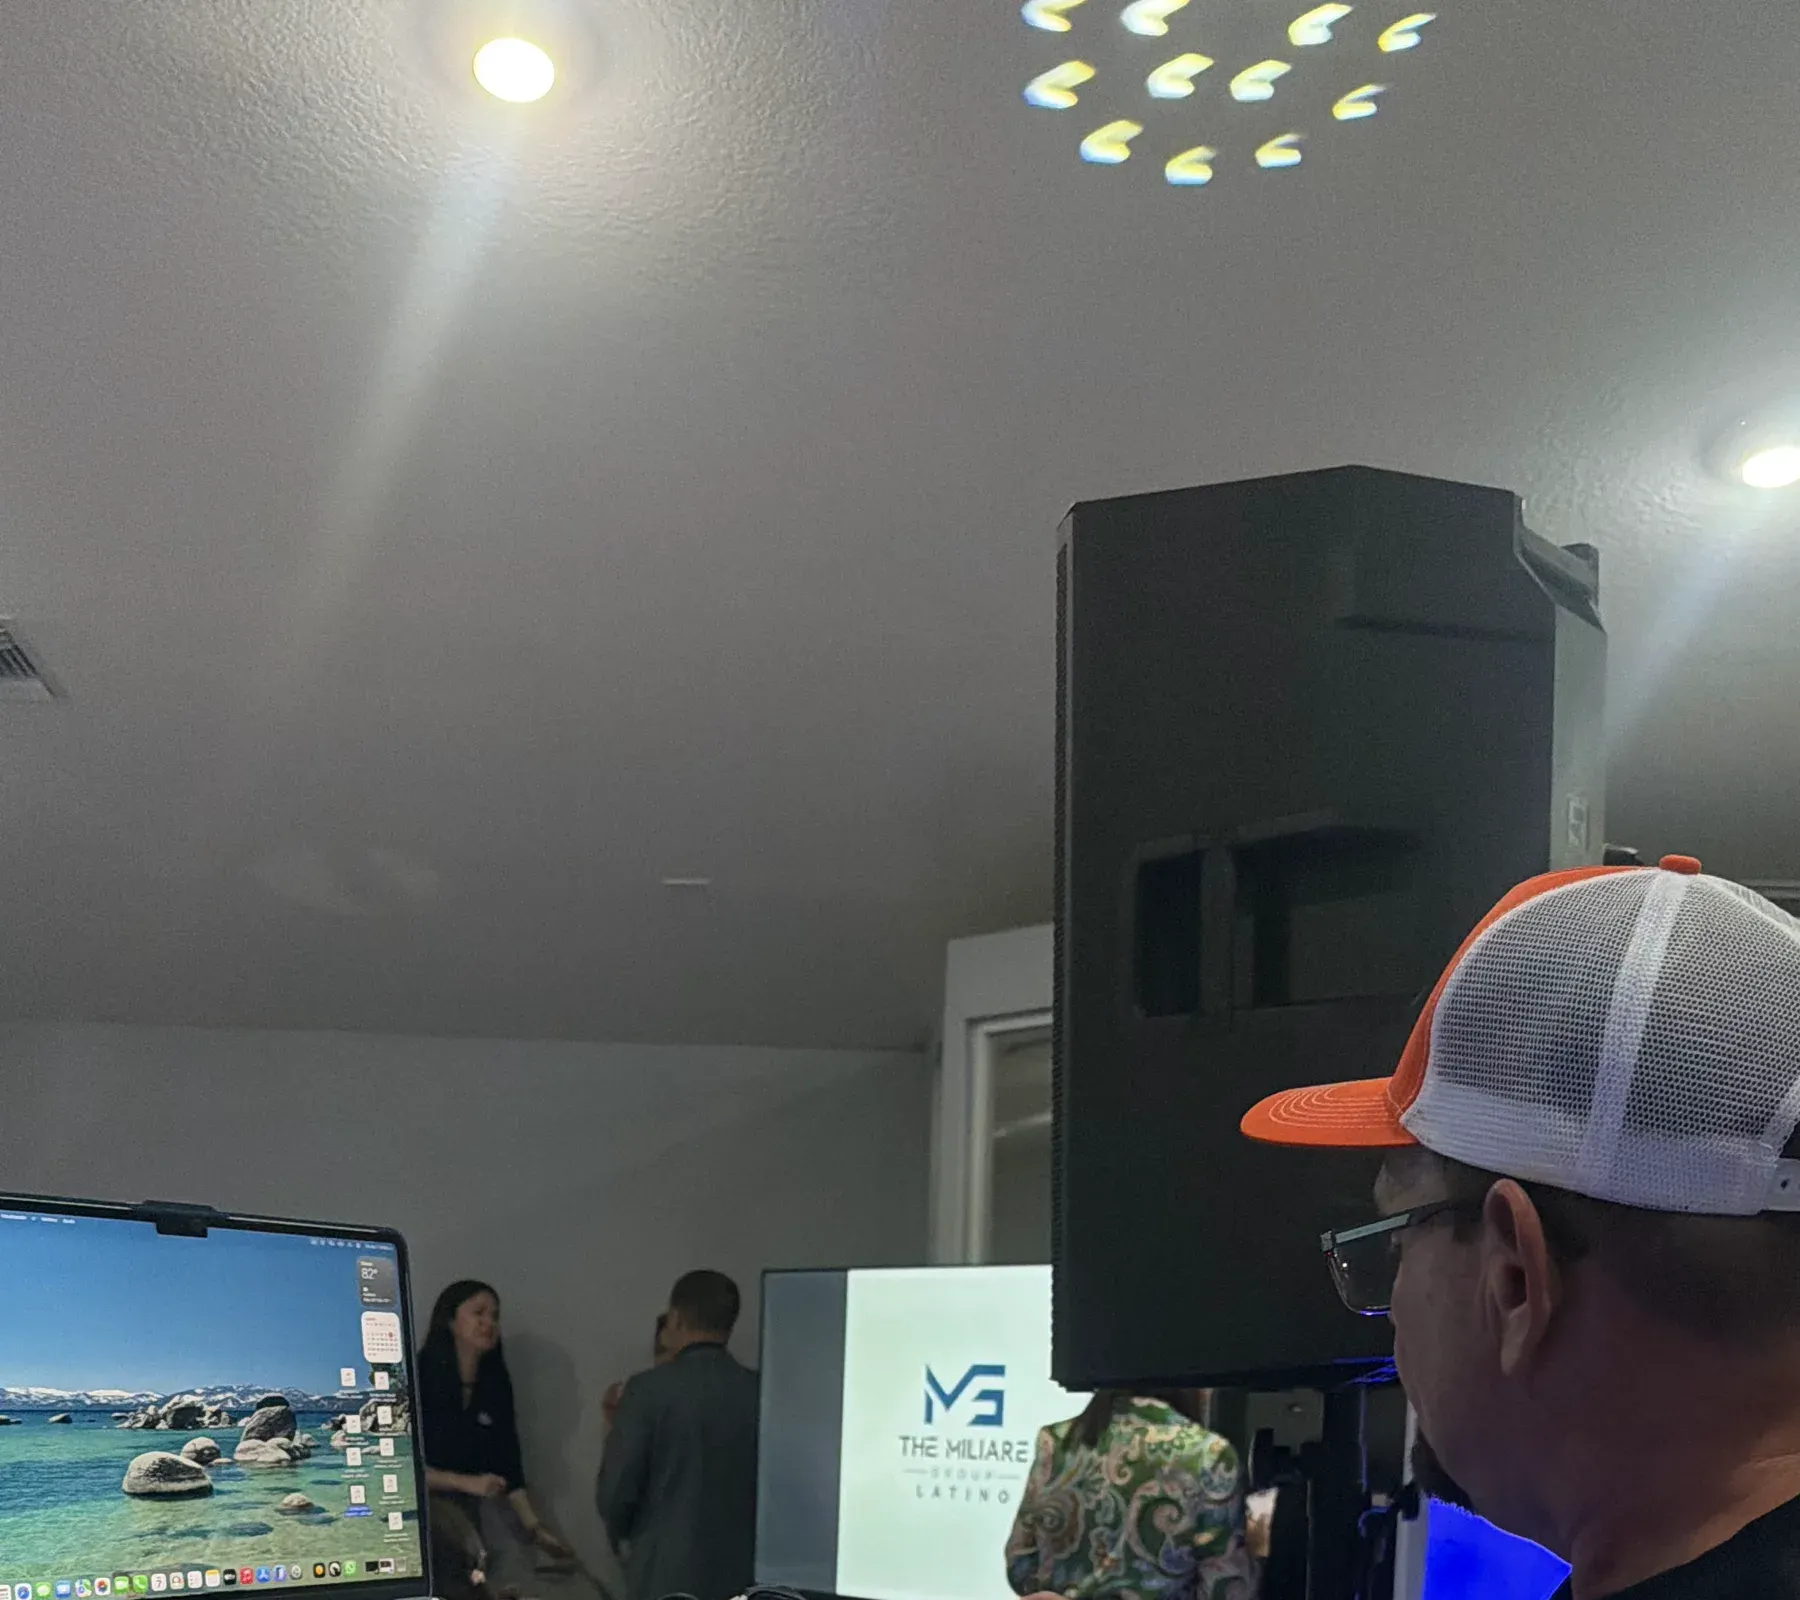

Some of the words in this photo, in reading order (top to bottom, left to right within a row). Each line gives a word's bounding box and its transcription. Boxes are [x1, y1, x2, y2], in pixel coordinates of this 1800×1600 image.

[899, 1435, 938, 1458] THE
[945, 1438, 1029, 1463] MILIARE
[915, 1484, 1010, 1505] LATINO
